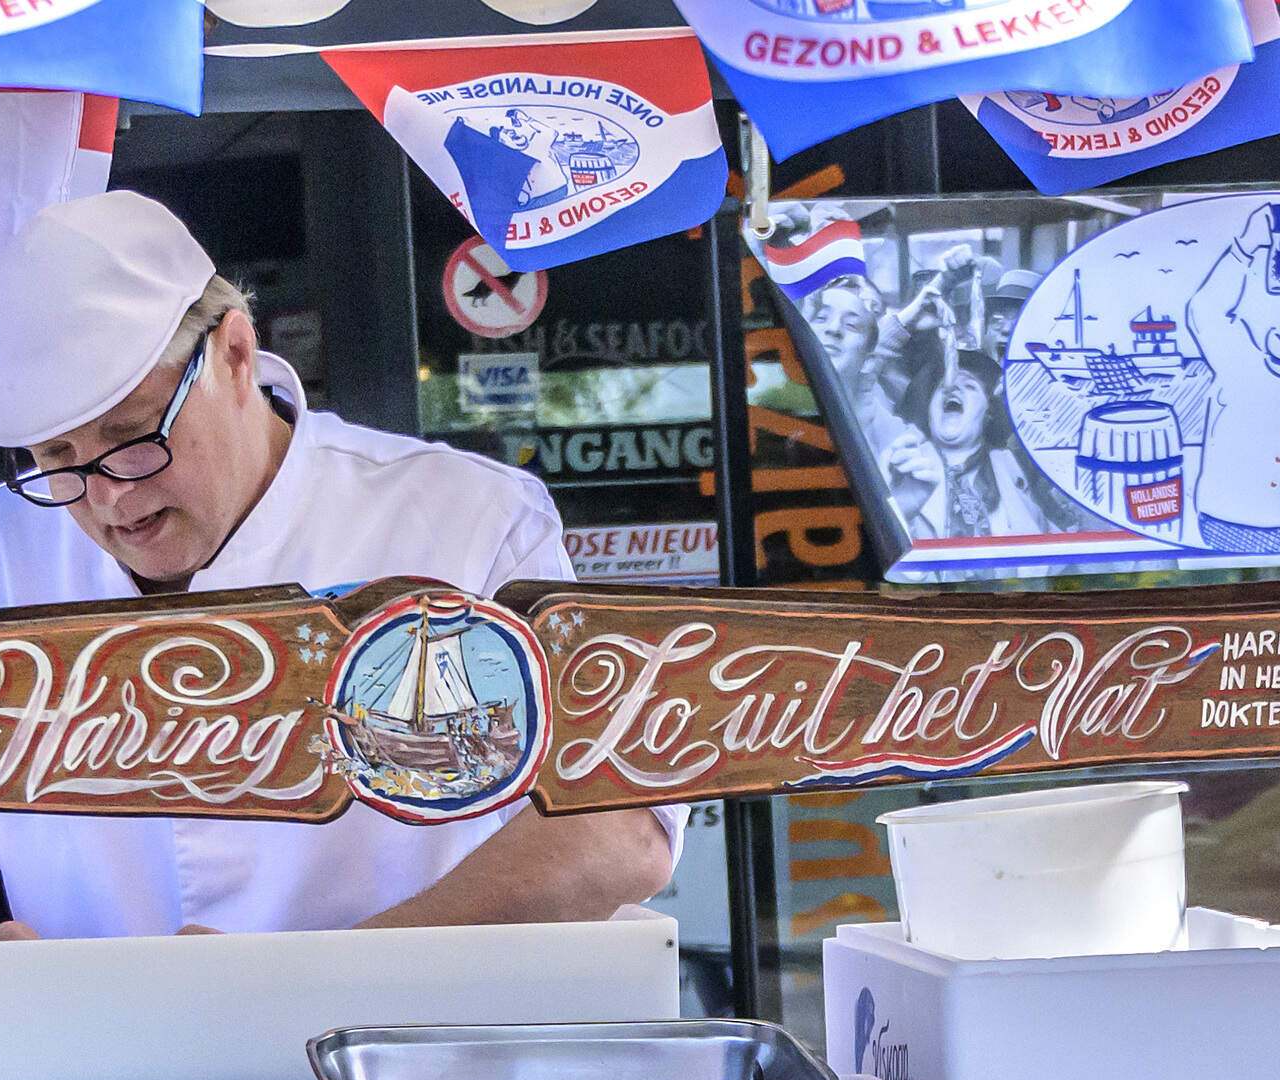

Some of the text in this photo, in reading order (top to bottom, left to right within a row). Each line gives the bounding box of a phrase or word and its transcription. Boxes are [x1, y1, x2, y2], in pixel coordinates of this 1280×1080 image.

[745, 31, 902, 67] GEZOND
[917, 30, 941, 54] &
[1131, 483, 1179, 505] HOLLANDSE
[1137, 499, 1180, 519] NIEUWE
[1220, 664, 1247, 691] IN
[710, 641, 860, 754] uit
[861, 638, 1018, 744] het
[1016, 626, 1210, 760] Vat
